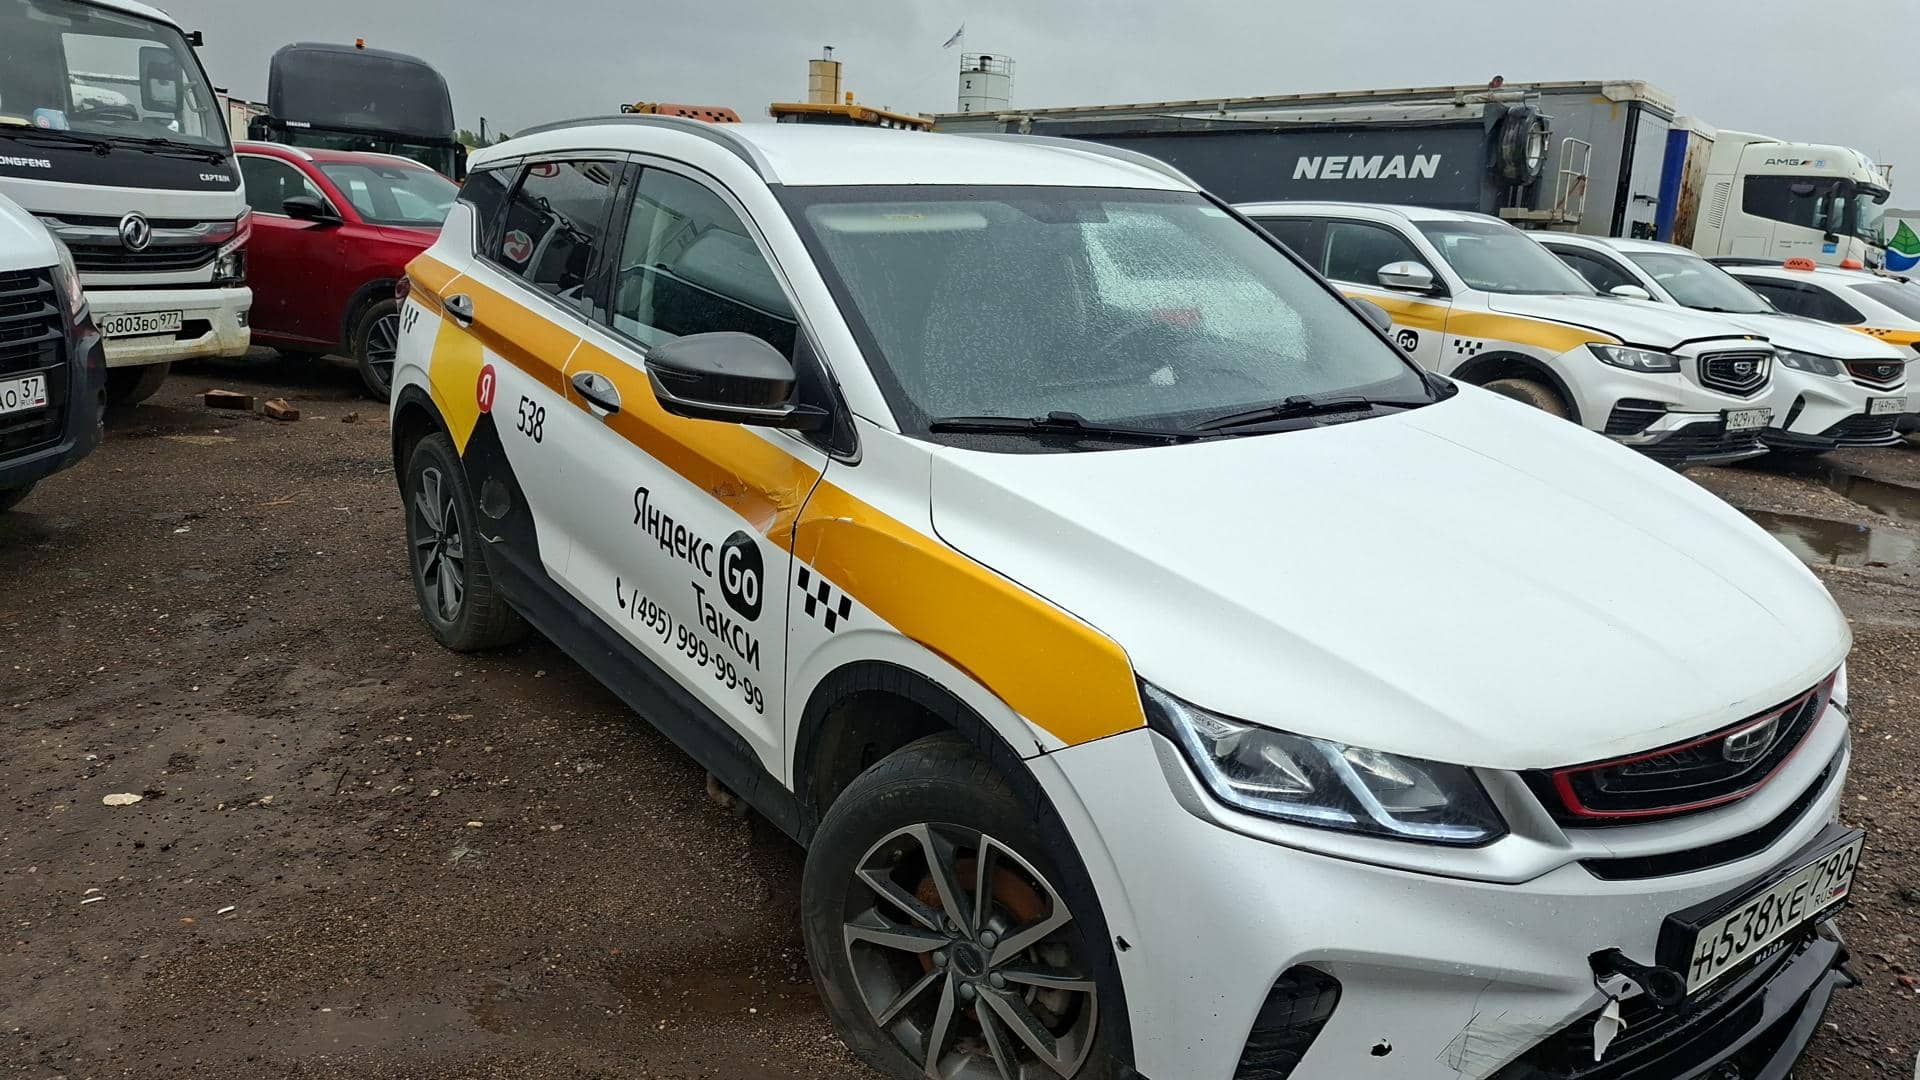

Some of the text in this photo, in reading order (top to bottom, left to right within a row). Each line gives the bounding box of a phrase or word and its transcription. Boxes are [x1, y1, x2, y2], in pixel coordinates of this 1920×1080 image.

[199, 173, 231, 182] CAPTAIN
[1292, 154, 1441, 180] NEMAN
[1764, 158, 1800, 166] AMG
[22, 378, 39, 398] 37
[480, 374, 492, 405] Я
[516, 394, 546, 444] 538
[633, 486, 759, 606] Яндекс Go
[691, 580, 760, 672] Такси
[630, 589, 764, 715] (495) 999-99-99
[1811, 846, 1854, 897] 790
[1814, 886, 1835, 908] RUS
